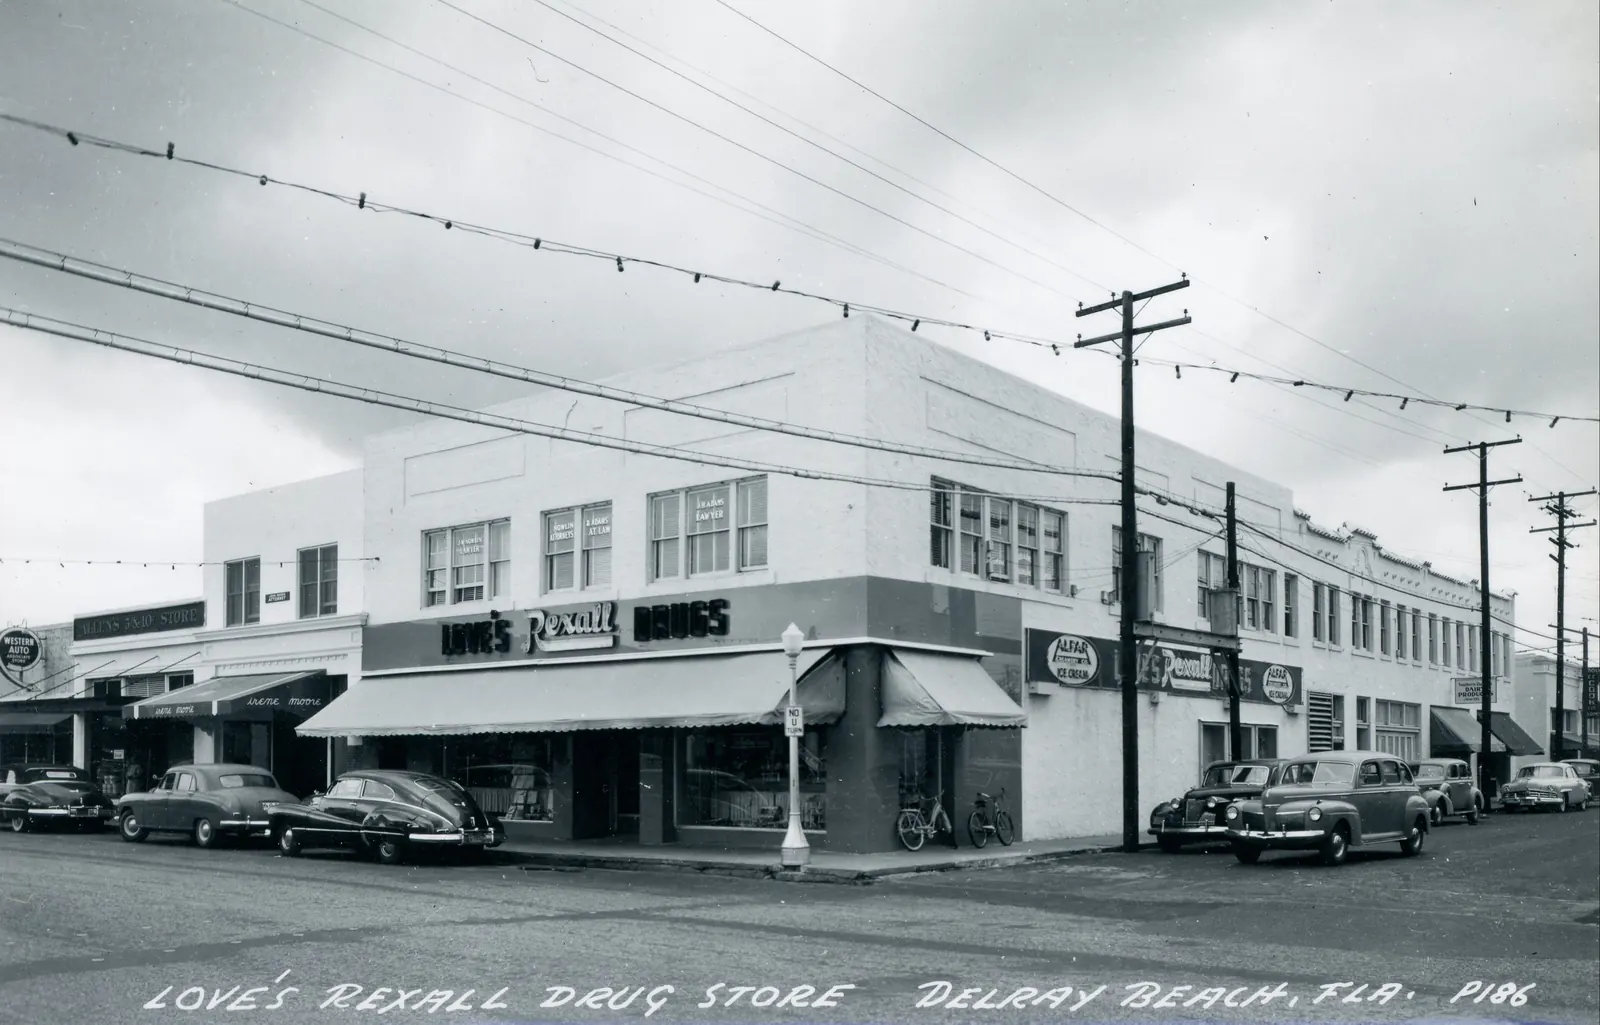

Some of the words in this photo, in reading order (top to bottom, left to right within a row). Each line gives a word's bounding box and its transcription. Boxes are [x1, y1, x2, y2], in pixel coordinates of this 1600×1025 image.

[696, 510, 724, 521] LAWYER
[588, 527, 597, 536] AT
[598, 525, 610, 535] LAW
[160, 608, 197, 625] STORE
[523, 601, 614, 653] Rexall
[634, 599, 730, 641] DRUGS
[3, 636, 35, 646] WESTERN
[8, 645, 30, 655] AUTO
[1057, 667, 1067, 678] ICE
[1161, 648, 1212, 688] Rexall
[789, 709, 799, 717] NO
[792, 718, 797, 726] U
